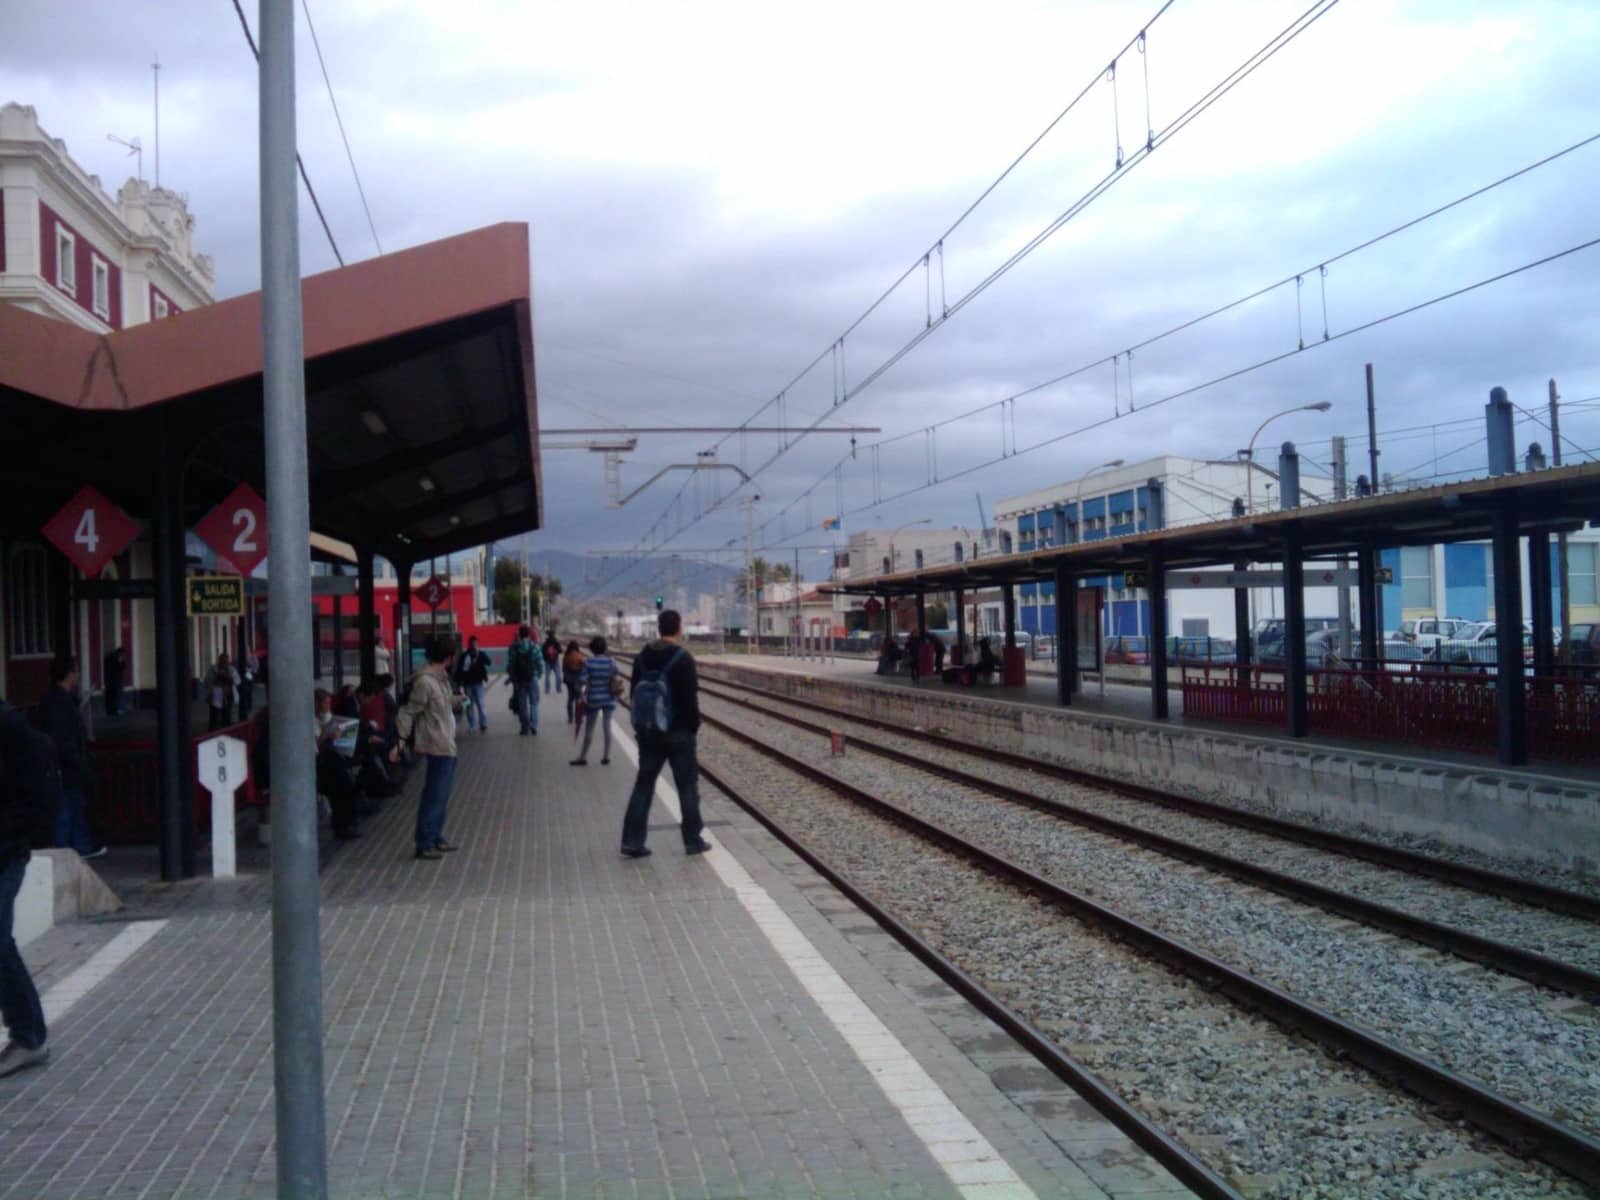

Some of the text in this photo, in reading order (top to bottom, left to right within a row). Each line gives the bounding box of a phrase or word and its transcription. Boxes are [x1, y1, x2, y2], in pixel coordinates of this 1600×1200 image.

[74, 508, 99, 552] 4
[231, 508, 257, 552] 2
[428, 585, 439, 603] 2
[217, 740, 226, 758] 8
[217, 766, 226, 783] 8
